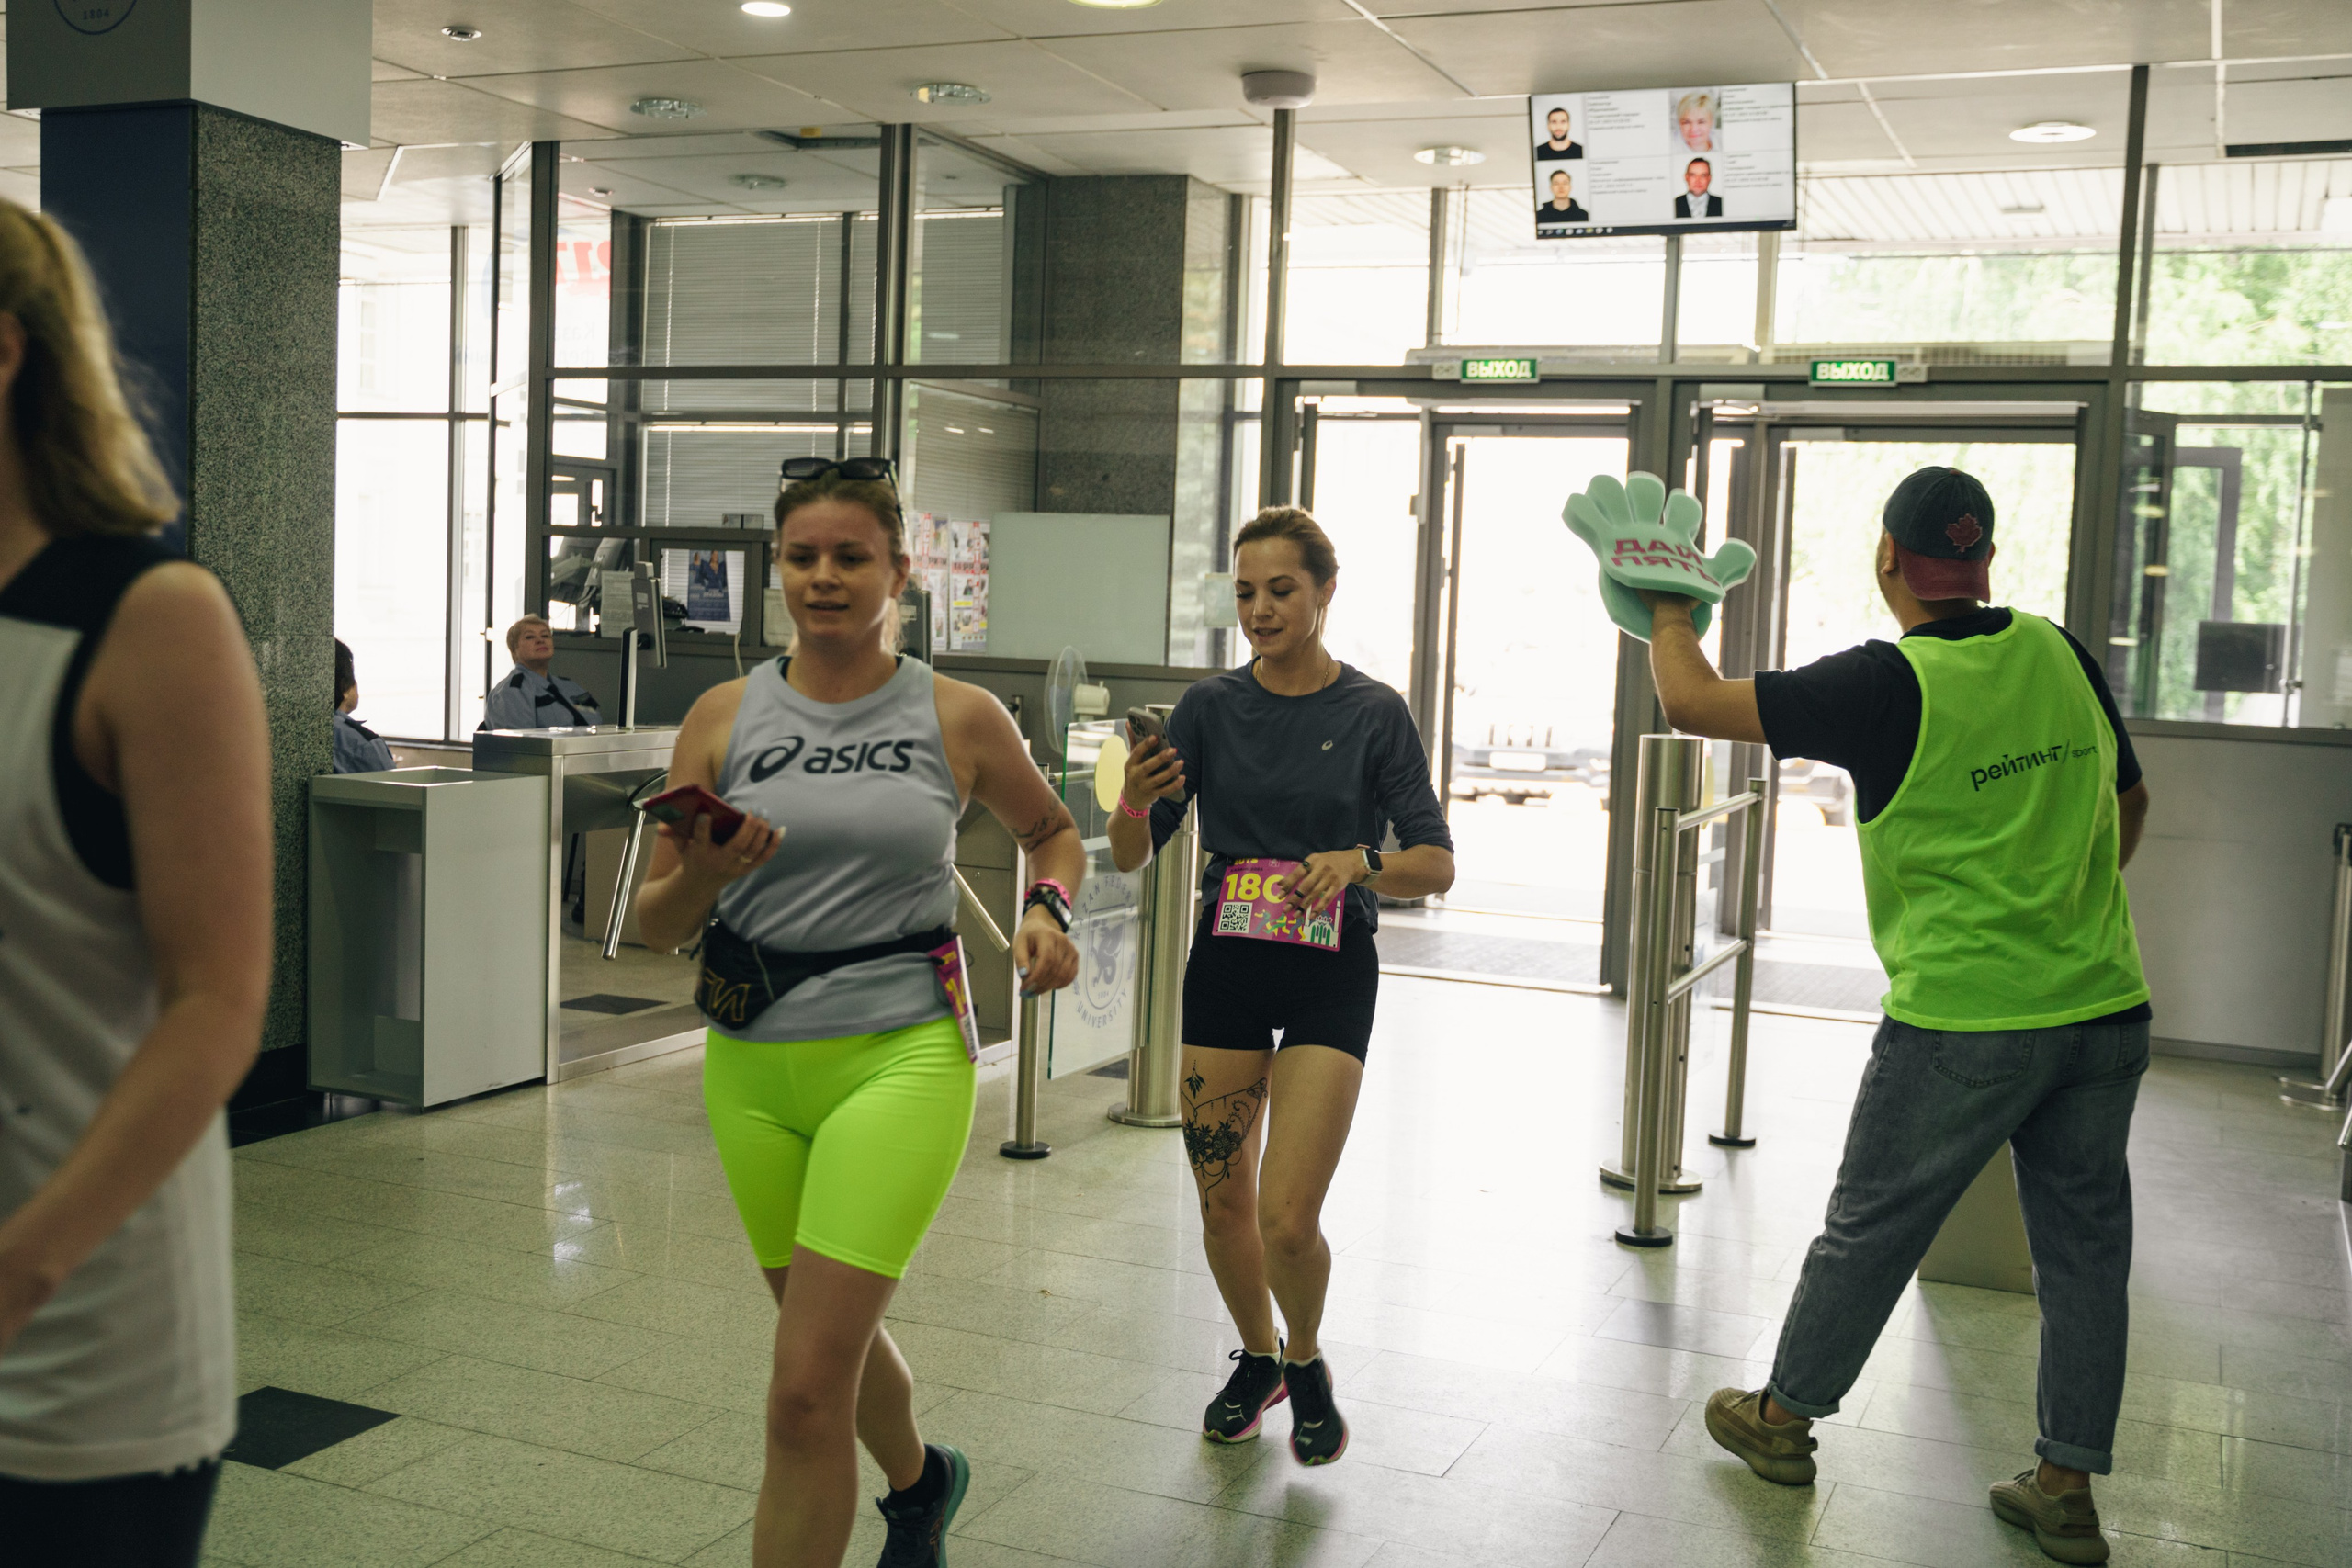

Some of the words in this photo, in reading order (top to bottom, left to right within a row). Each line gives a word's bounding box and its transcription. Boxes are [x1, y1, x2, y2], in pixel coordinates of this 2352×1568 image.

[1466, 360, 1532, 378] ВЫХОД
[1816, 362, 1890, 380] ВЫХОД
[1613, 538, 1703, 567] ДАЙ
[1611, 556, 1722, 587] ПЯТЬ
[803, 740, 914, 774] asics
[1076, 987, 1127, 1029] UNIVERSITY
